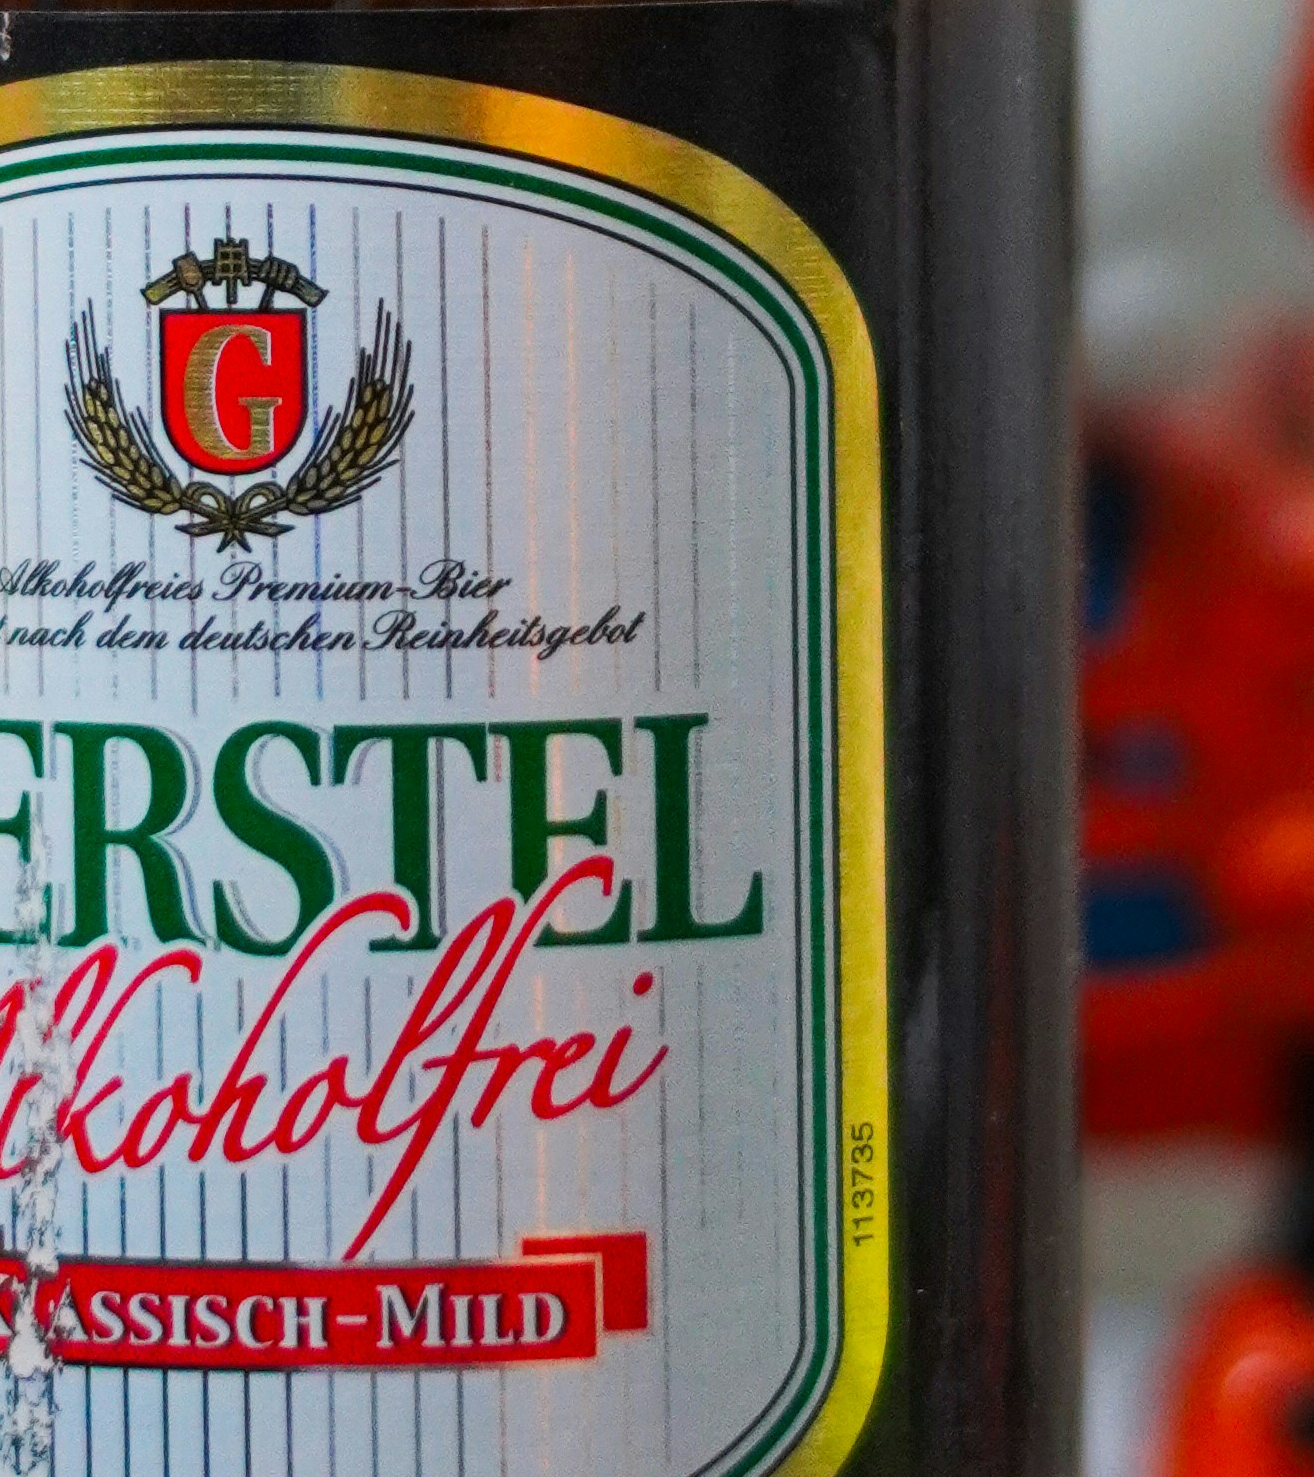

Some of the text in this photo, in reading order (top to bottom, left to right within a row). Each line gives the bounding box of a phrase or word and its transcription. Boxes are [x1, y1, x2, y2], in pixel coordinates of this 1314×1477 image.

[183, 324, 283, 460] G
[211, 557, 513, 602] Premium-Bier
[5, 609, 87, 648] nach
[95, 614, 170, 651] dem
[178, 611, 357, 651] deutschen
[361, 605, 646, 661] Reinheitsgebot
[850, 1121, 875, 1248] 113735
